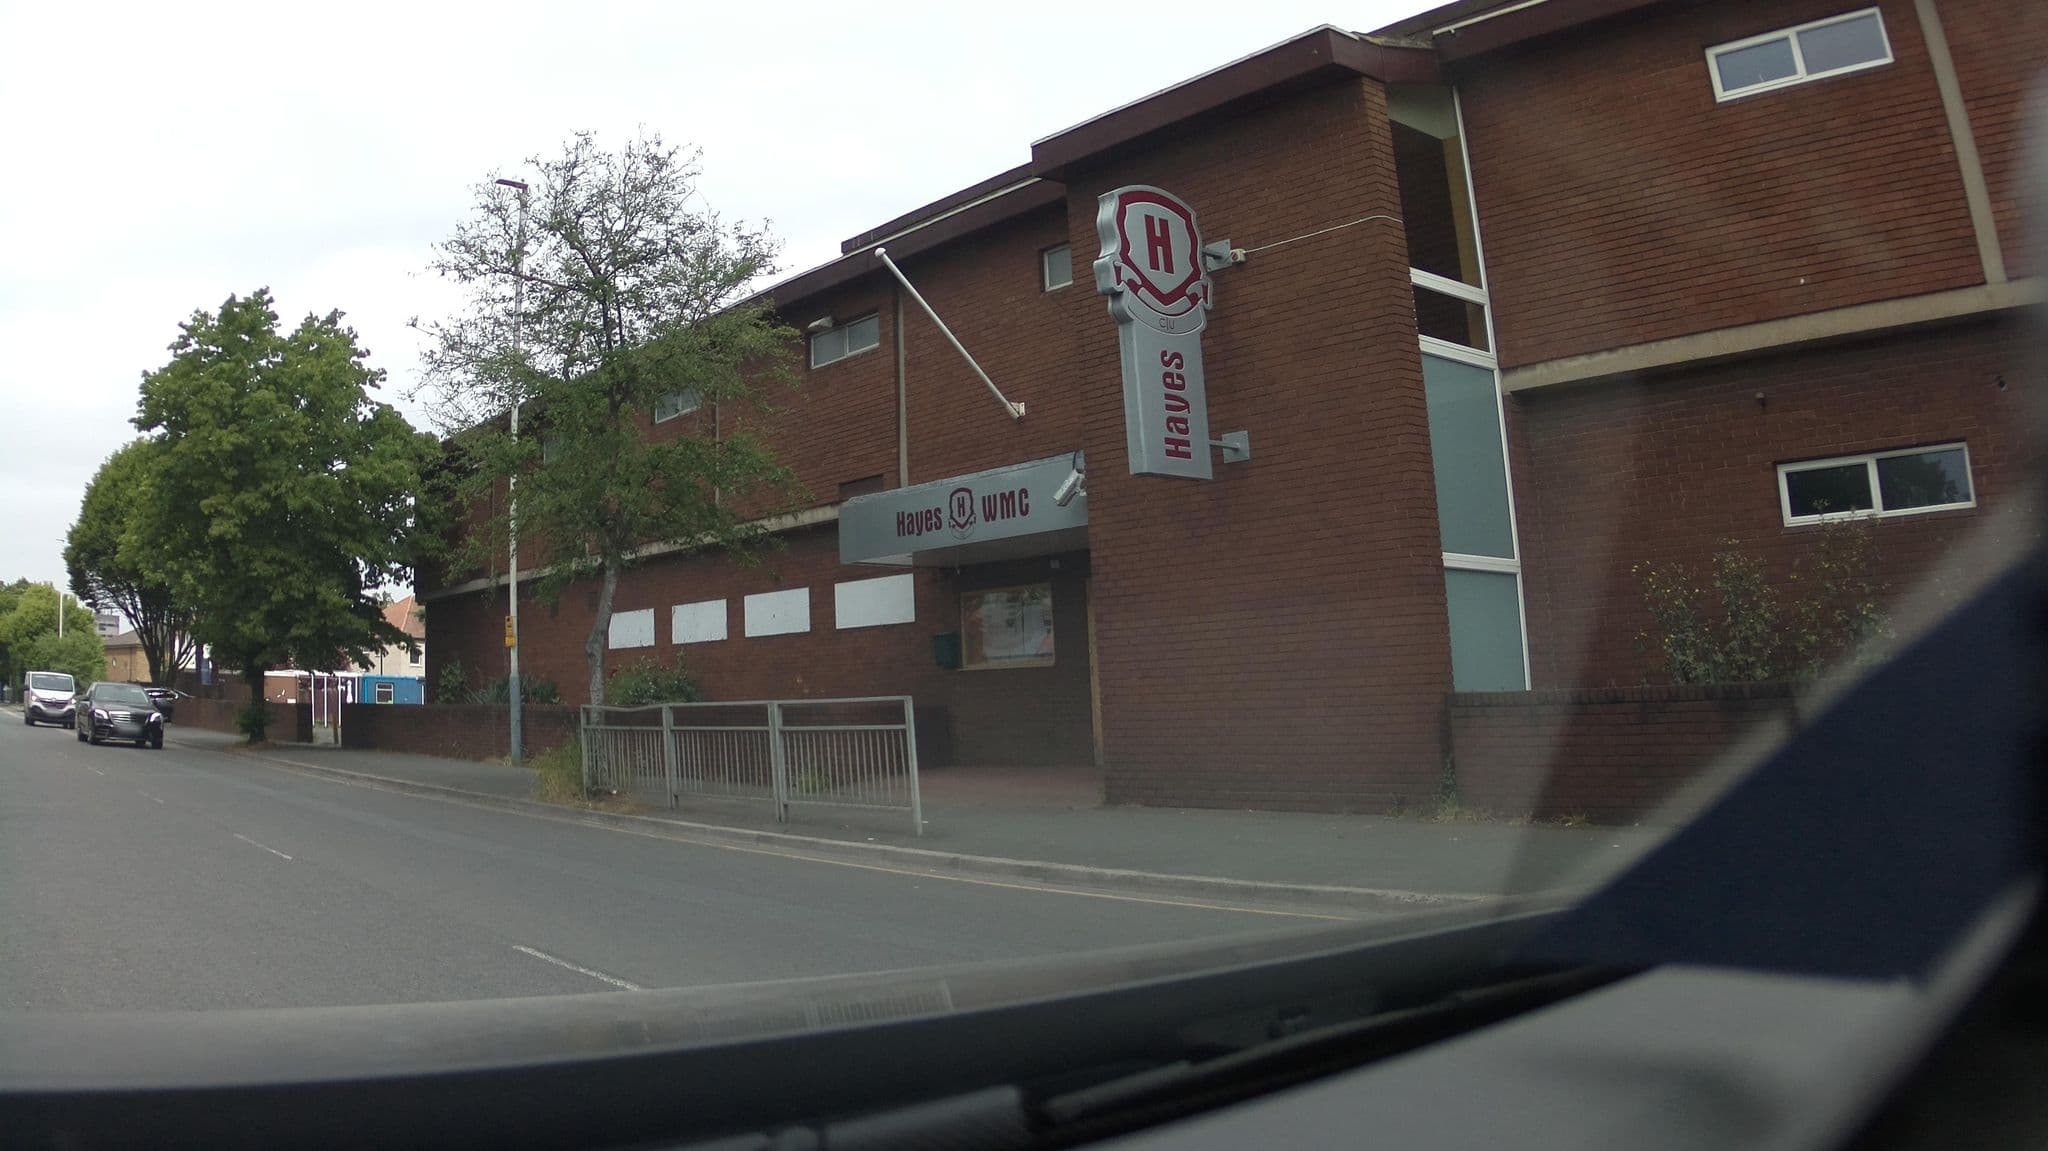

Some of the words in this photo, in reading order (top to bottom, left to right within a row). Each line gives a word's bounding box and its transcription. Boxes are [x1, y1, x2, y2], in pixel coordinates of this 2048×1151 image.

[1144, 214, 1175, 275] H
[1160, 350, 1192, 460] Hayes
[896, 506, 942, 537] Hayes
[957, 496, 965, 517] H
[982, 488, 1030, 522] WMC
